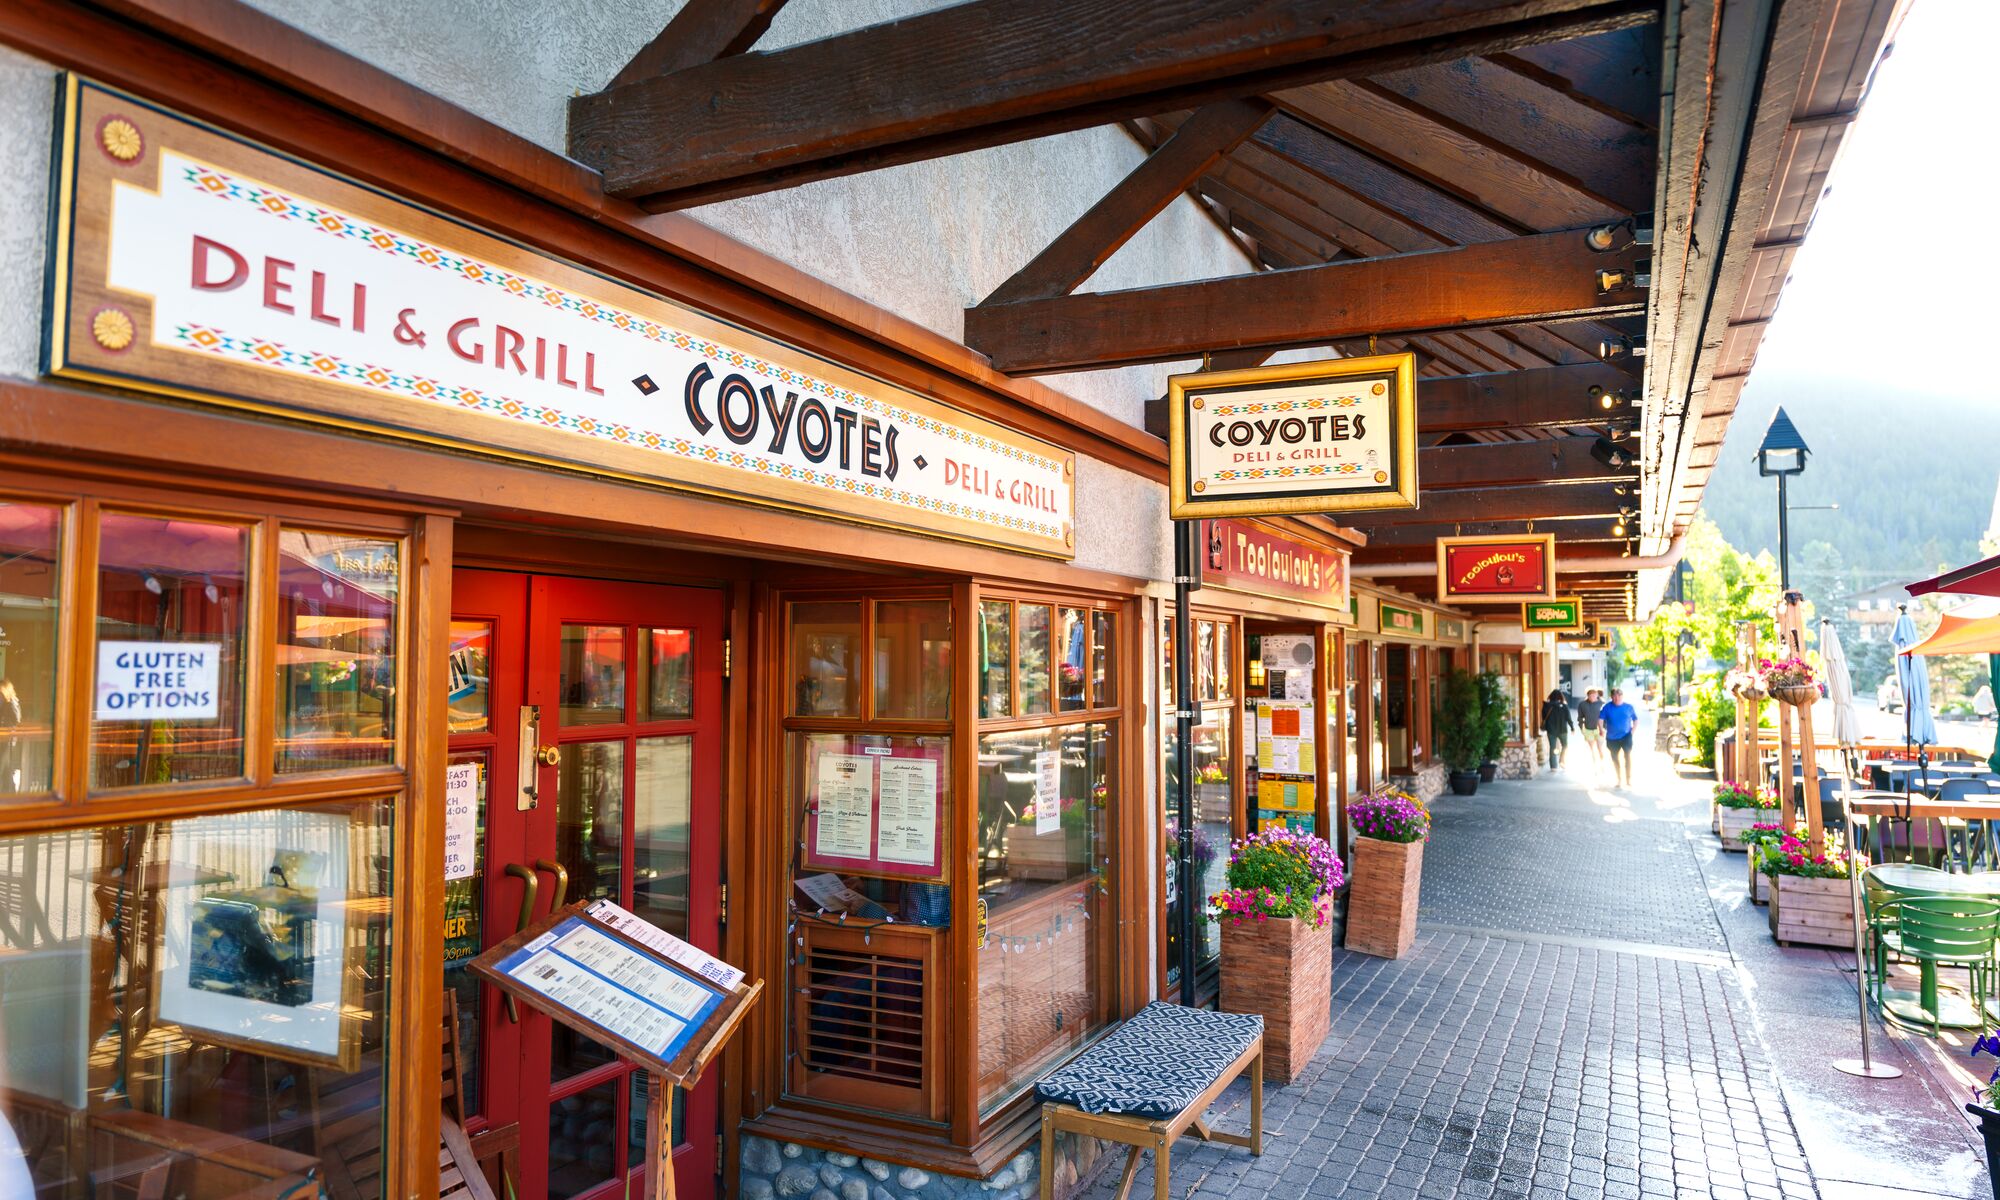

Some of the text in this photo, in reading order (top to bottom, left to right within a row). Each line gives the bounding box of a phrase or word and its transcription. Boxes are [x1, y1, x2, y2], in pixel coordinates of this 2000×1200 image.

[191, 234, 1057, 513] DELI & GRILL COYOTES DELI & GRILL
[1210, 414, 1366, 447] COYOTES
[1233, 447, 1341, 463] DELI & GRILL
[1237, 532, 1319, 589] Tooloulou's
[1461, 553, 1525, 584] Tooloulou's
[116, 652, 204, 668] GLUTEN
[135, 672, 186, 688] FREE
[107, 691, 209, 709] OPTIONS
[448, 770, 469, 779] FAST
[446, 797, 459, 806] CH
[445, 854, 459, 863] ER
